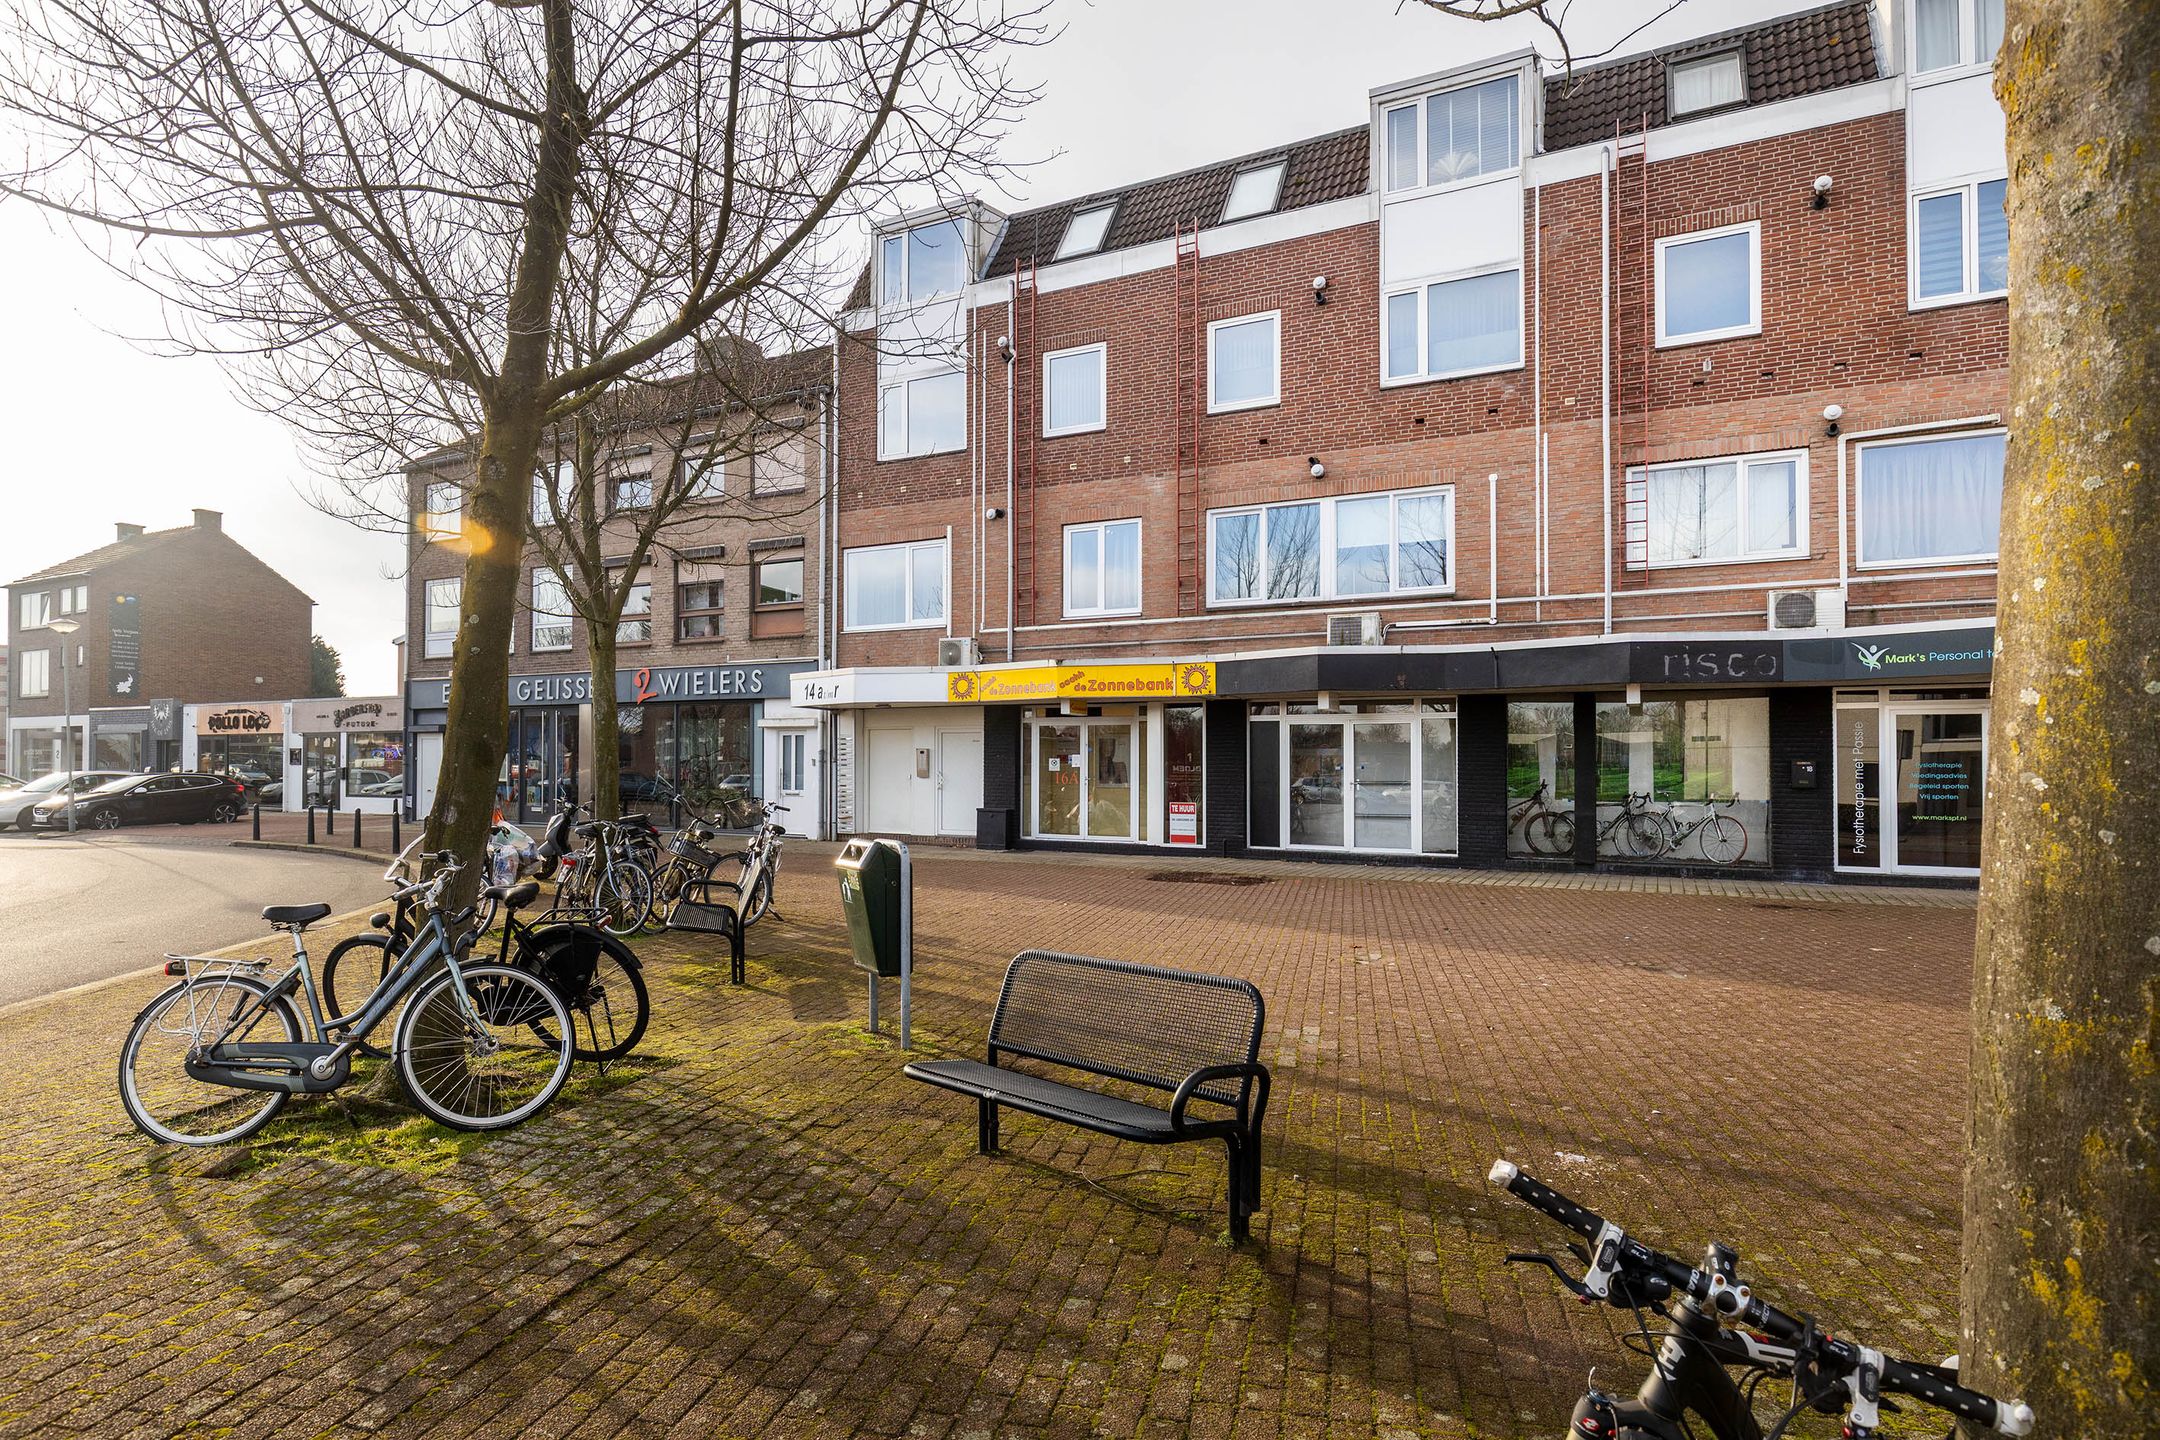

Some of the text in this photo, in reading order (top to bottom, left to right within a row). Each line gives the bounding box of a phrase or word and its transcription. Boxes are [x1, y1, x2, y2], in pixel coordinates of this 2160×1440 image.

[1885, 653, 1926, 664] Mark's
[1929, 650, 1984, 662] Personal
[805, 683, 815, 700] 14
[1074, 678, 1174, 692] de Zonnebank
[1055, 771, 1079, 784] 16A
[1853, 721, 1867, 854] Fysiotherapie met Passie
[1171, 804, 1195, 813] TE HUUR
